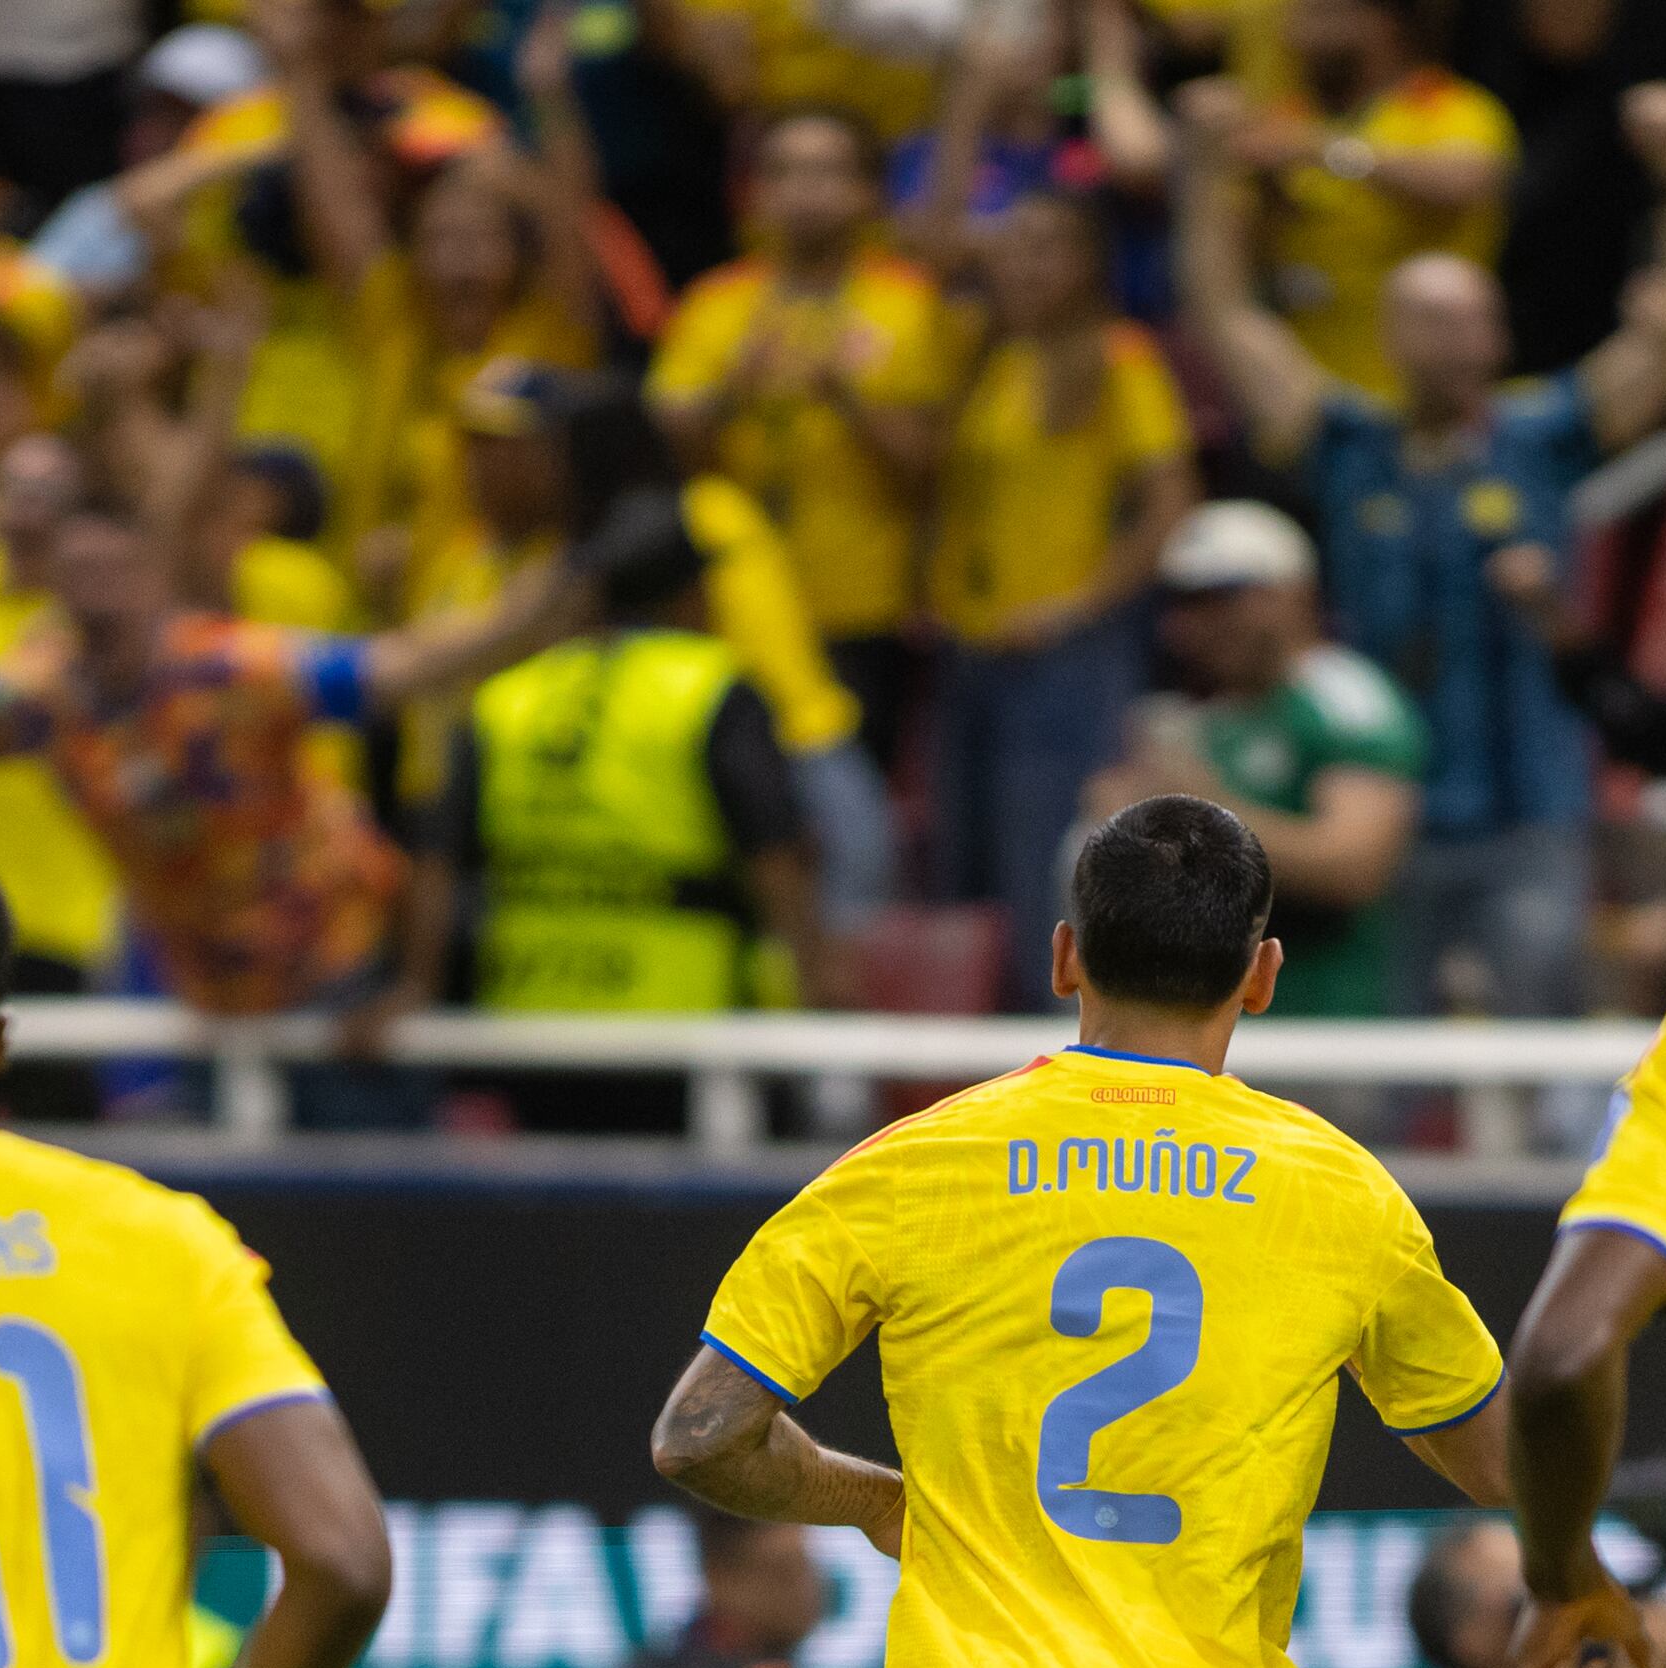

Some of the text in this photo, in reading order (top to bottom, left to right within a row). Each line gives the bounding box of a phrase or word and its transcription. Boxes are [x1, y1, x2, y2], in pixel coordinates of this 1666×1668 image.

[1090, 1086, 1177, 1106] COLOMBIA
[1007, 1127, 1258, 1205] D.MUÑOZ
[1036, 1236, 1204, 1545] 2
